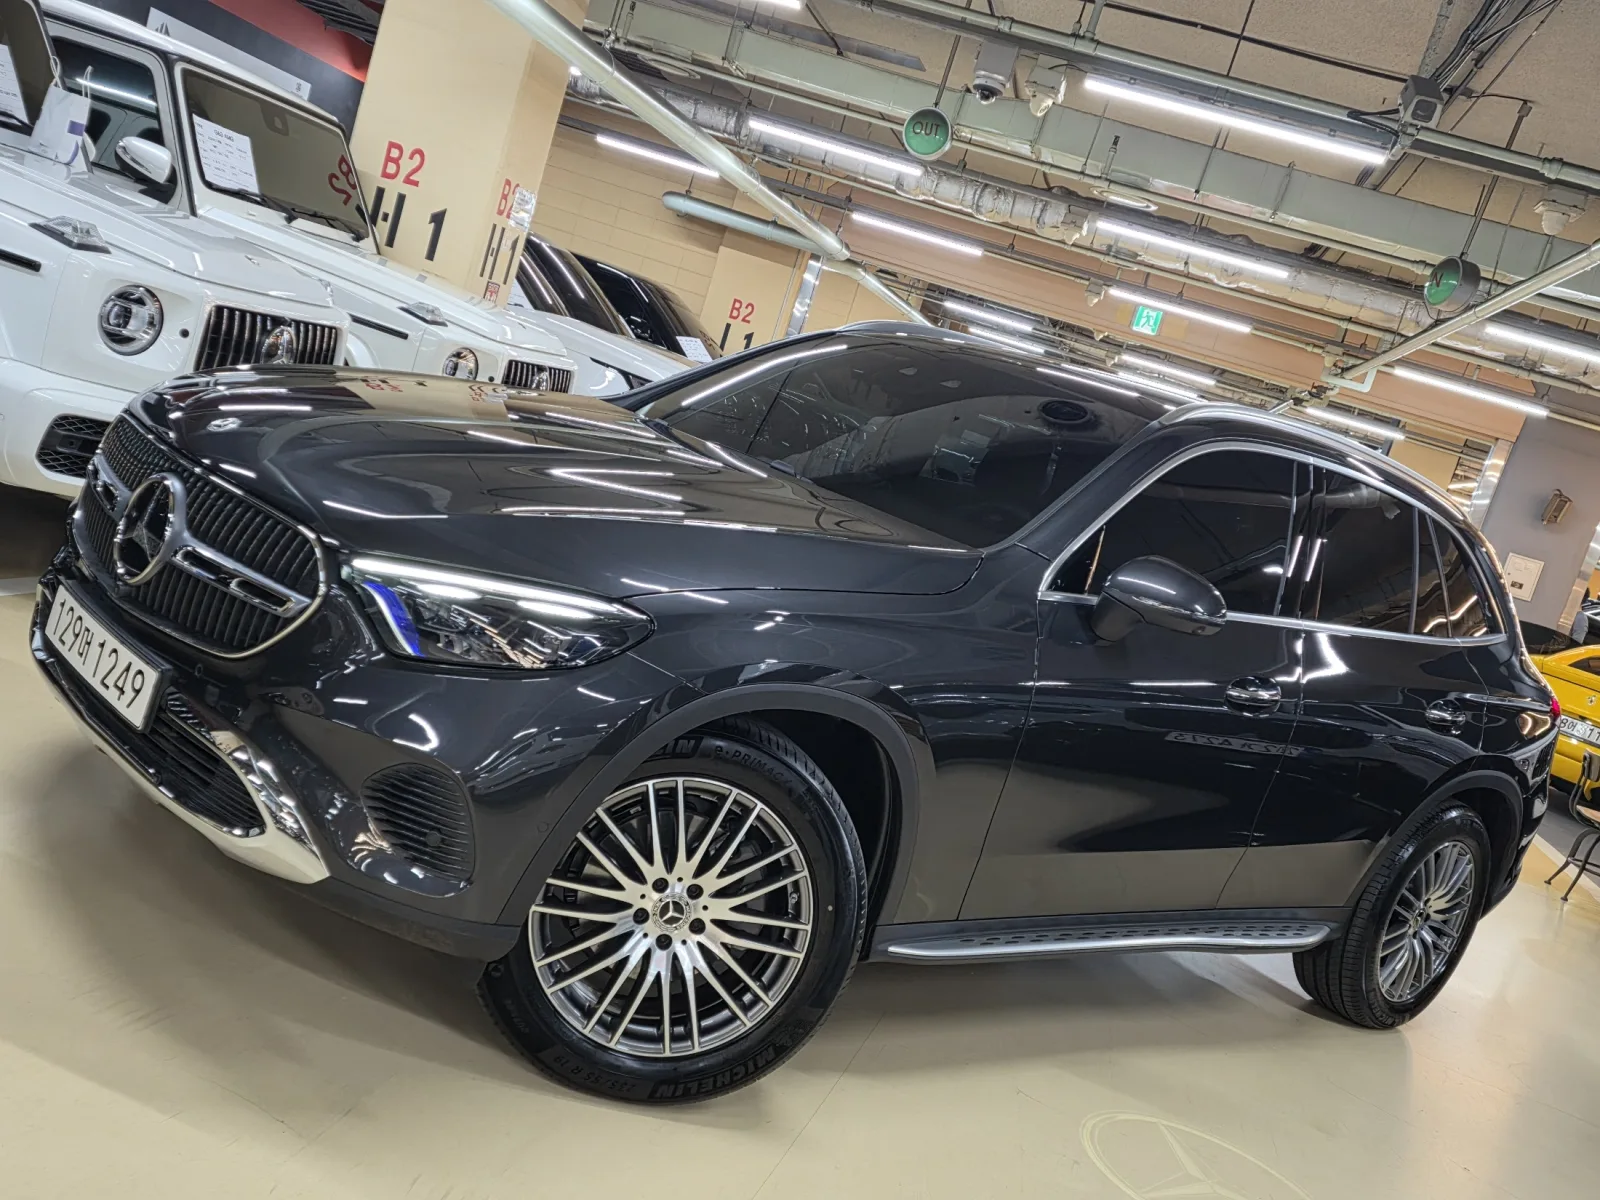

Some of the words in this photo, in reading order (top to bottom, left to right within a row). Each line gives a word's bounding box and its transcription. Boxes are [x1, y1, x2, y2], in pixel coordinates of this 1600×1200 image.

[912, 121, 940, 137] OUT
[380, 140, 426, 188] B2
[728, 297, 755, 324] B2
[655, 1045, 777, 1098] MICHELIN
